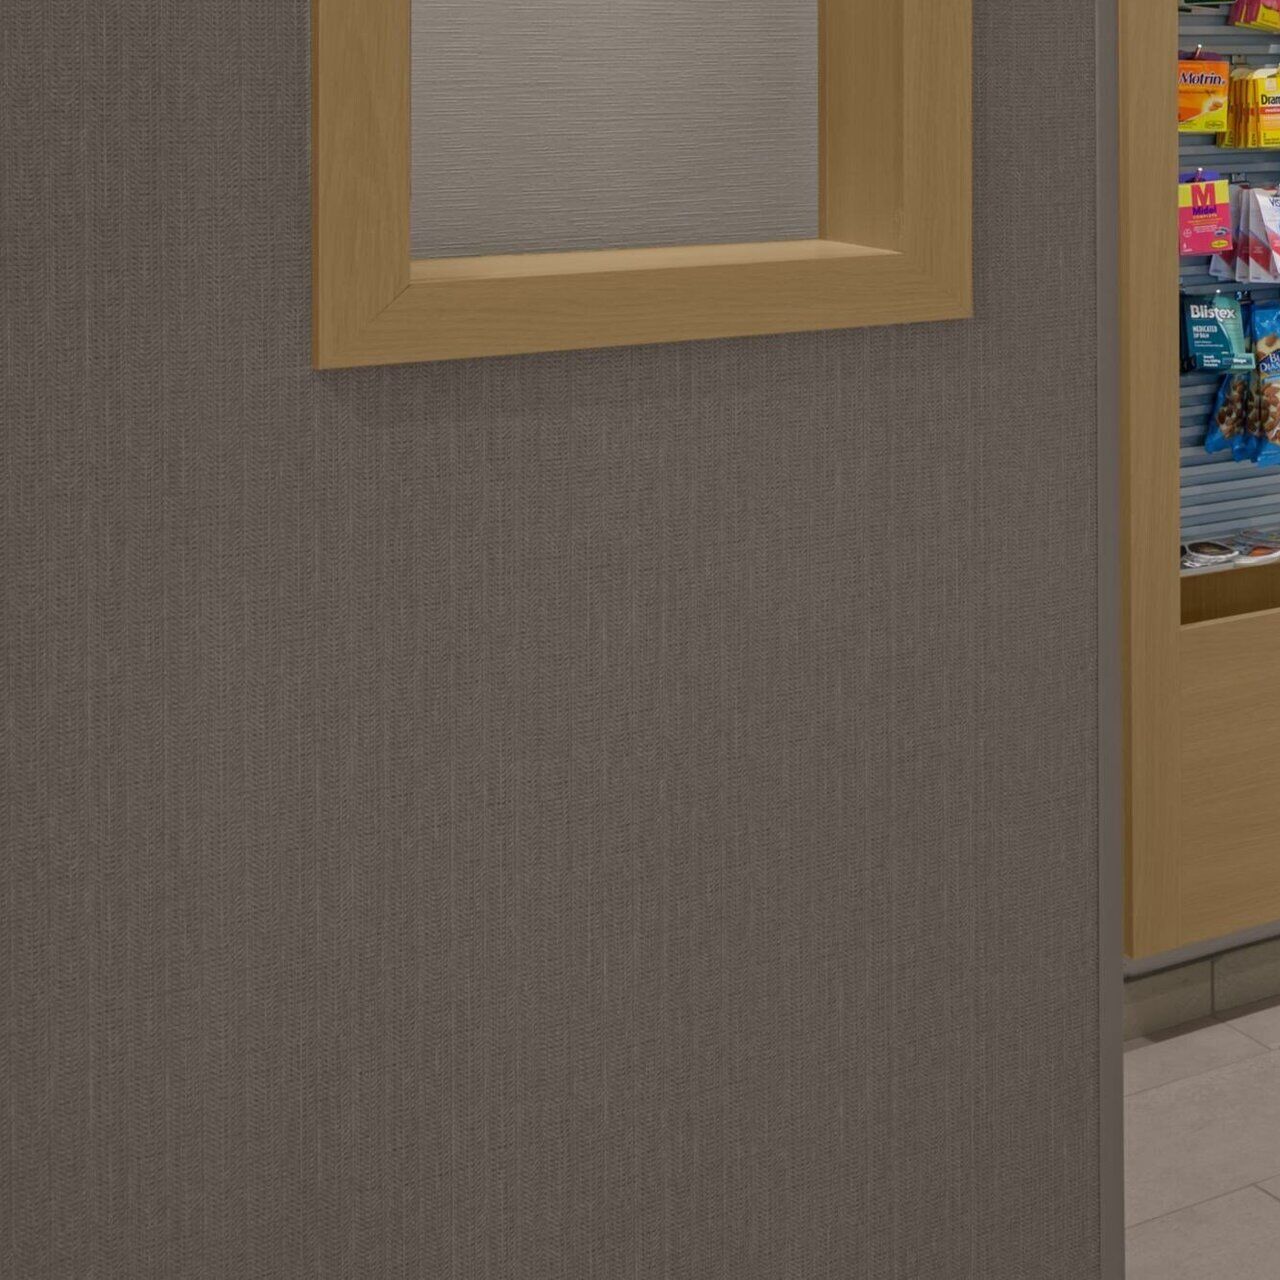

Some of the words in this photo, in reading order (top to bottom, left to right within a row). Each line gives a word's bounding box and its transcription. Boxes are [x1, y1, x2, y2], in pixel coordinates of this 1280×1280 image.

[1179, 73, 1222, 86] Motrin
[1190, 183, 1216, 206] M
[1192, 205, 1217, 215] Midol
[1190, 305, 1236, 320] Blistex
